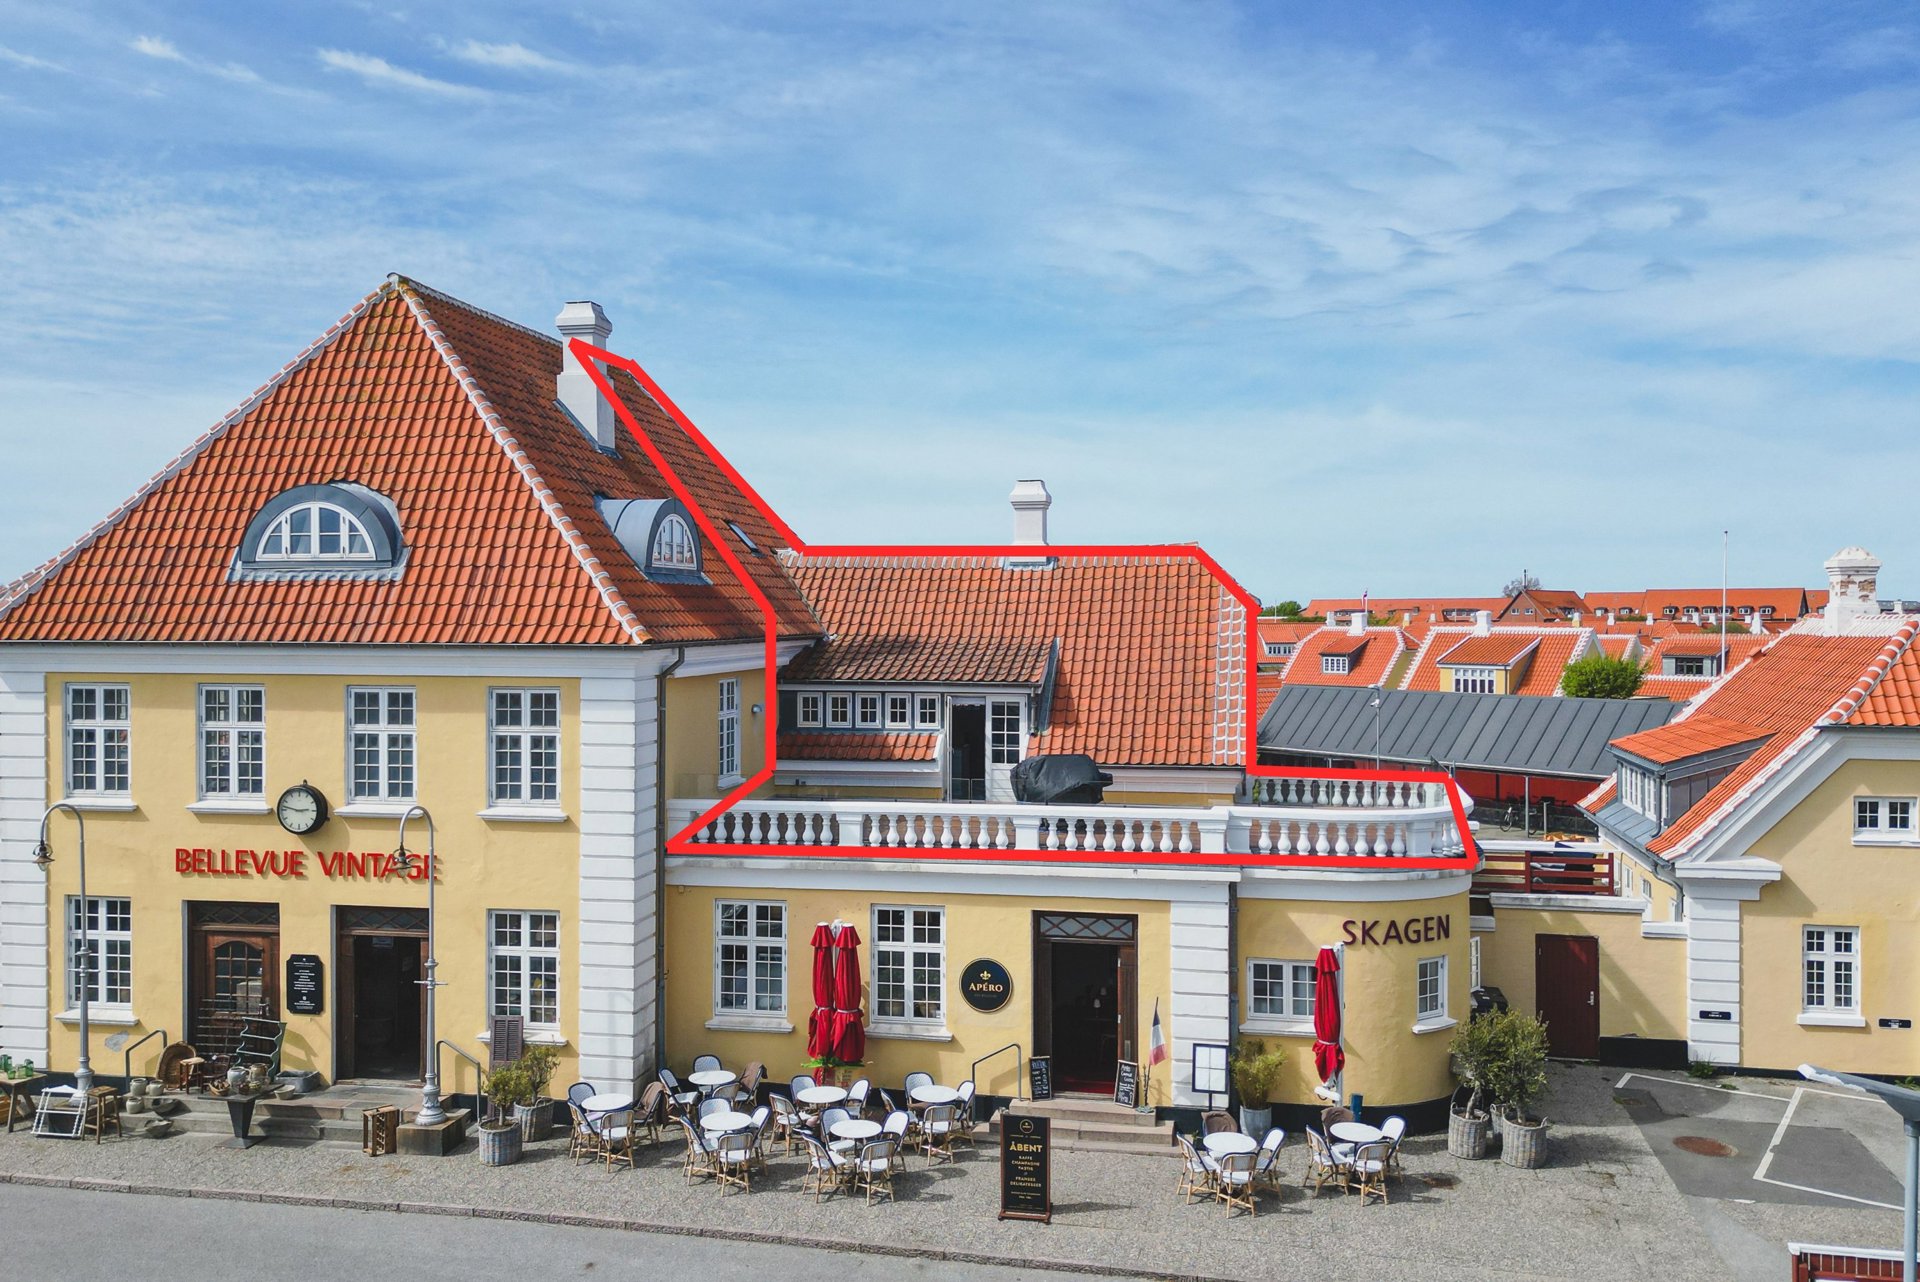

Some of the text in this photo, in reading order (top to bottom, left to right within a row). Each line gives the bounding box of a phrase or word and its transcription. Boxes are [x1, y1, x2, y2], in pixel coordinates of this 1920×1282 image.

[175, 848, 438, 879] BELLEVUE VINTAGE
[1342, 914, 1450, 945] SKAGEN
[969, 982, 1003, 992] APÉRO
[1009, 1141, 1043, 1153] ÅBENT
